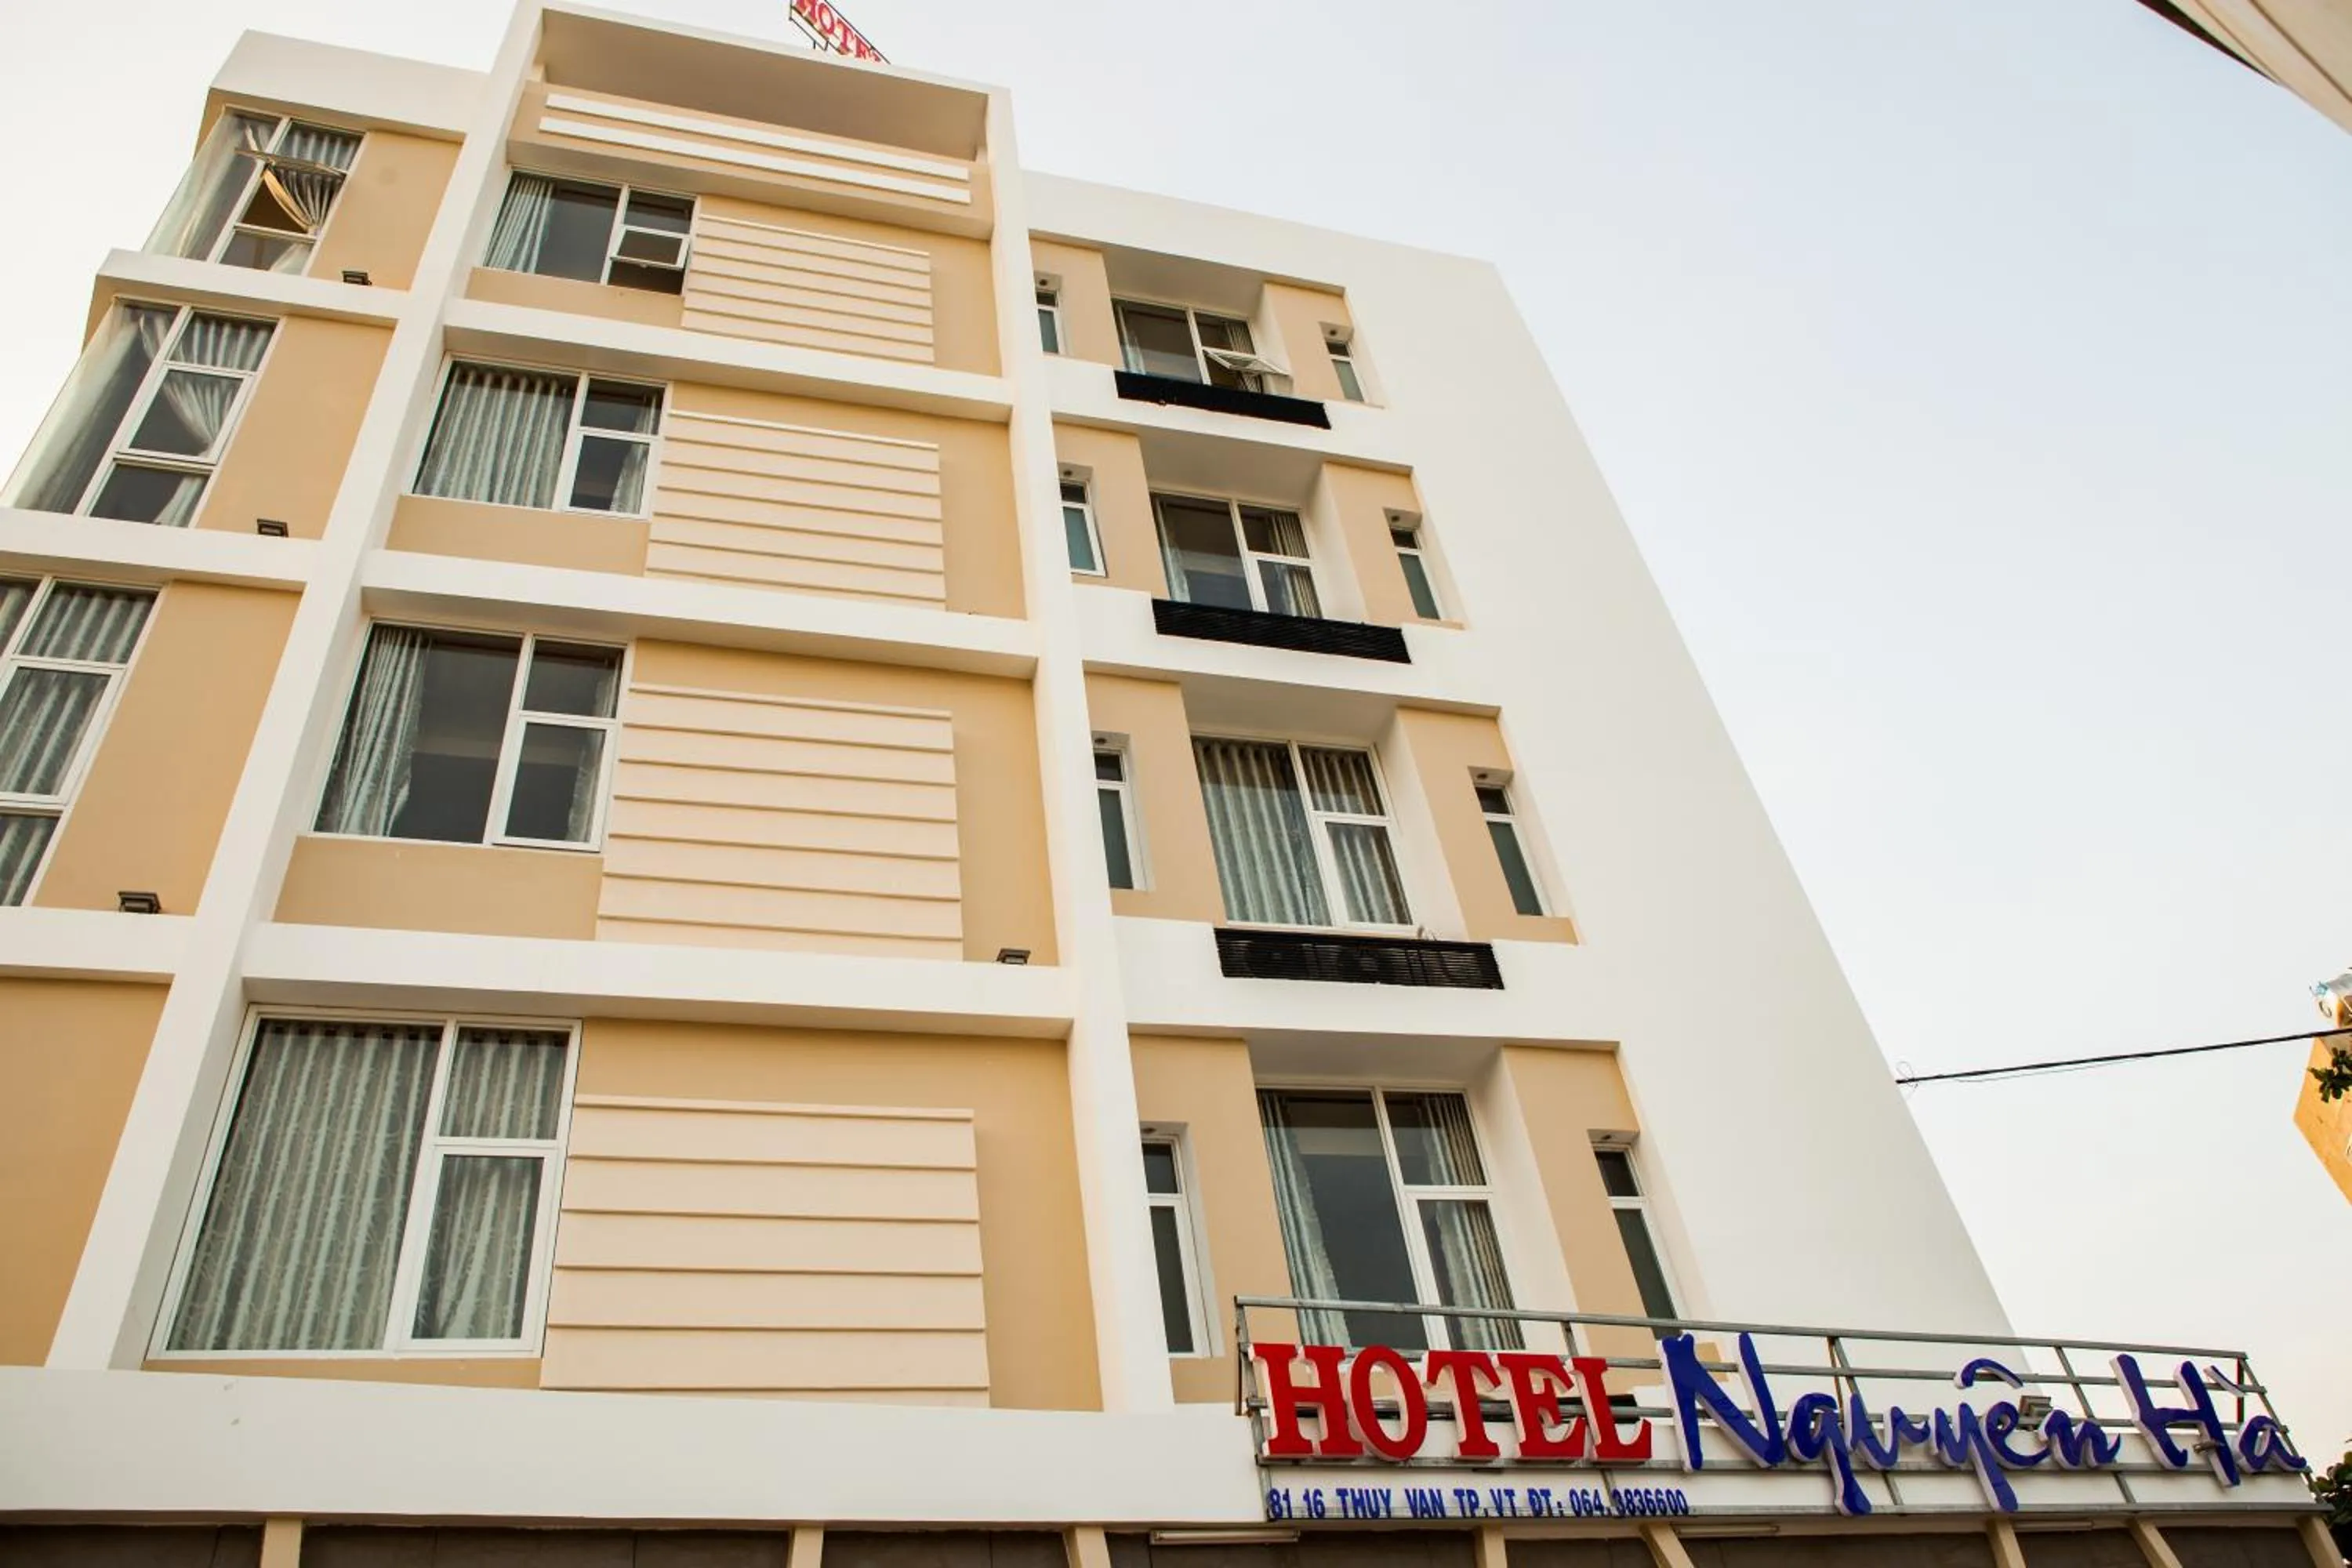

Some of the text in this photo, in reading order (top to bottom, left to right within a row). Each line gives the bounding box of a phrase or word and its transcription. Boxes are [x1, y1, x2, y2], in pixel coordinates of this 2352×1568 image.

[1250, 1343, 1652, 1463] HOTEL
[1337, 1488, 1392, 1519] THUY
[1404, 1488, 1446, 1519] VAN
